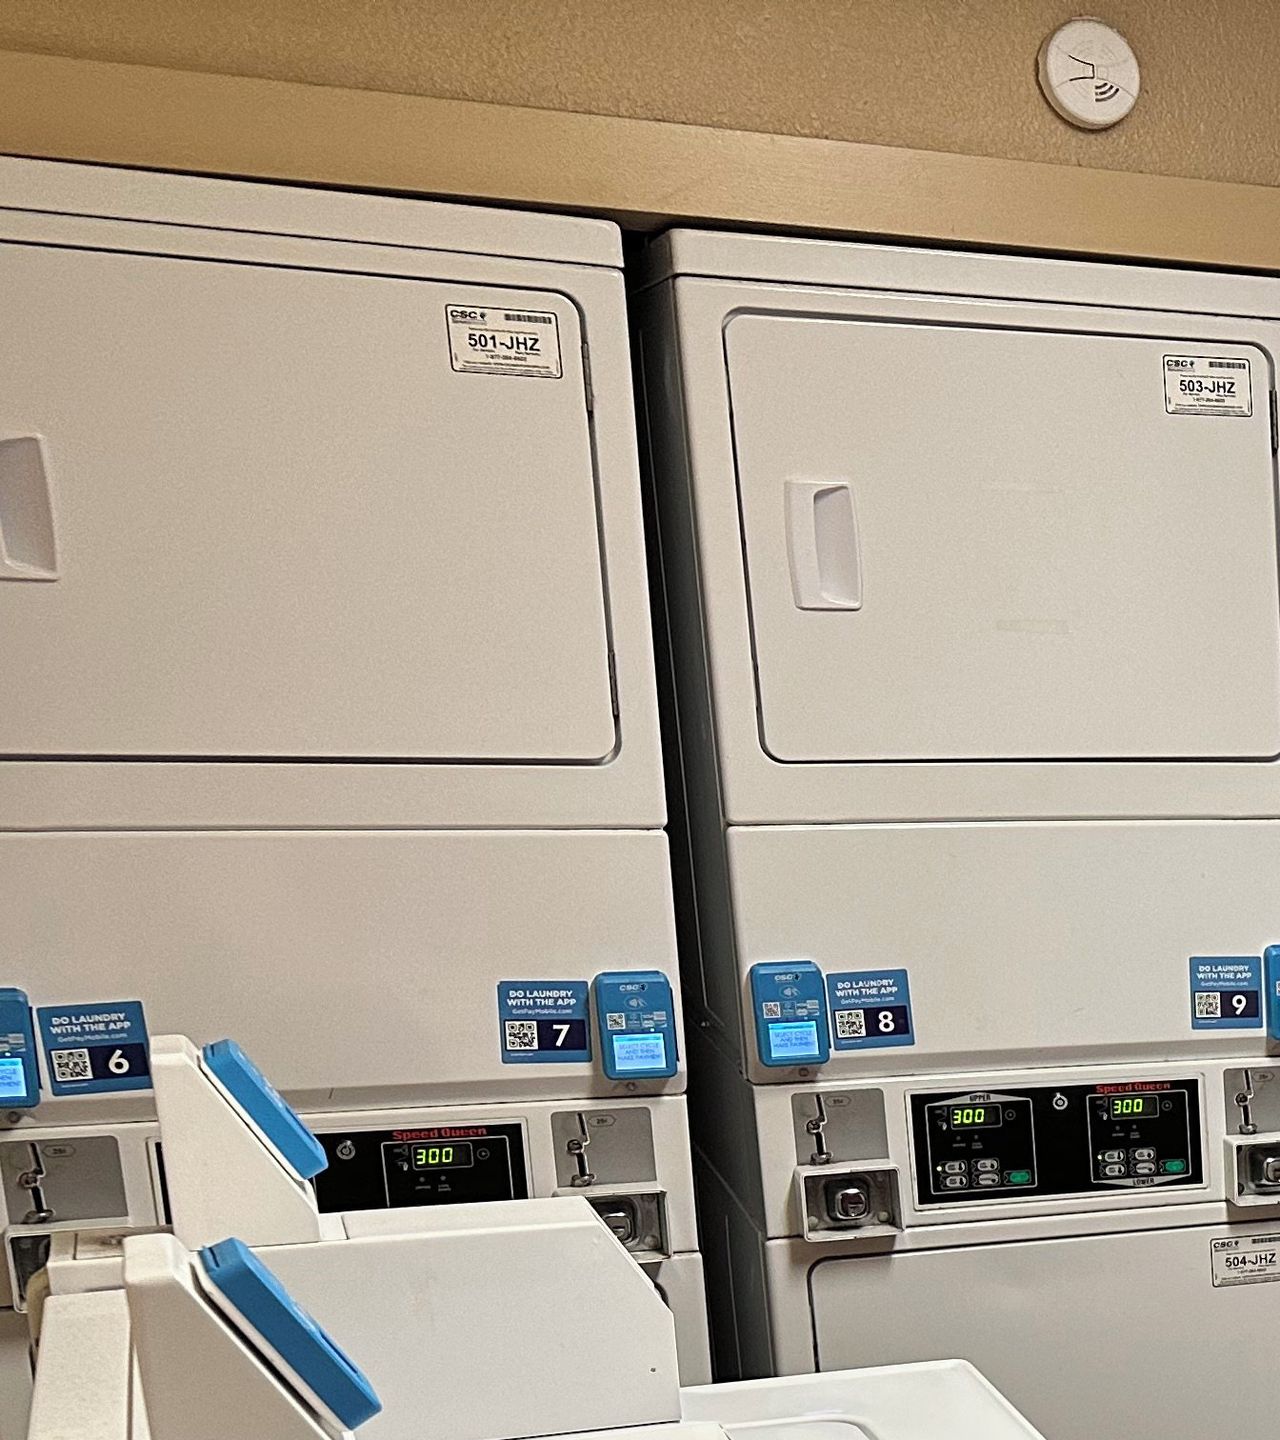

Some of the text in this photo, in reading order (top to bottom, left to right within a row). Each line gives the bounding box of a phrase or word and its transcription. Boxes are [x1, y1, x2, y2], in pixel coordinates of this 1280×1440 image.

[450, 310, 478, 319] CSC
[468, 333, 541, 352] 501-JHZ
[1166, 360, 1188, 368] CSC
[1180, 380, 1236, 394] 503-JHZ
[852, 979, 894, 988] LAUNDRY
[510, 990, 572, 998] DO LAUNDRY
[880, 986, 898, 994] APP
[535, 998, 554, 1006] THE
[556, 998, 576, 1006] APP
[1232, 994, 1246, 1015] 9
[52, 1013, 126, 1025] DO LAUNDRY
[878, 1011, 895, 1032] 8
[50, 1022, 132, 1034] WITH THE APP
[552, 1024, 570, 1046] 7
[108, 1050, 130, 1074] 6
[1096, 1082, 1170, 1094] Speed Queen
[969, 1094, 990, 1102] UPPER
[1114, 1099, 1142, 1114] 300
[952, 1108, 984, 1124] 300
[392, 1128, 487, 1140] Speed Queen
[416, 1148, 453, 1164] 300
[1132, 1178, 1154, 1186] LOWER
[1226, 1252, 1276, 1268] 504-JHZ
